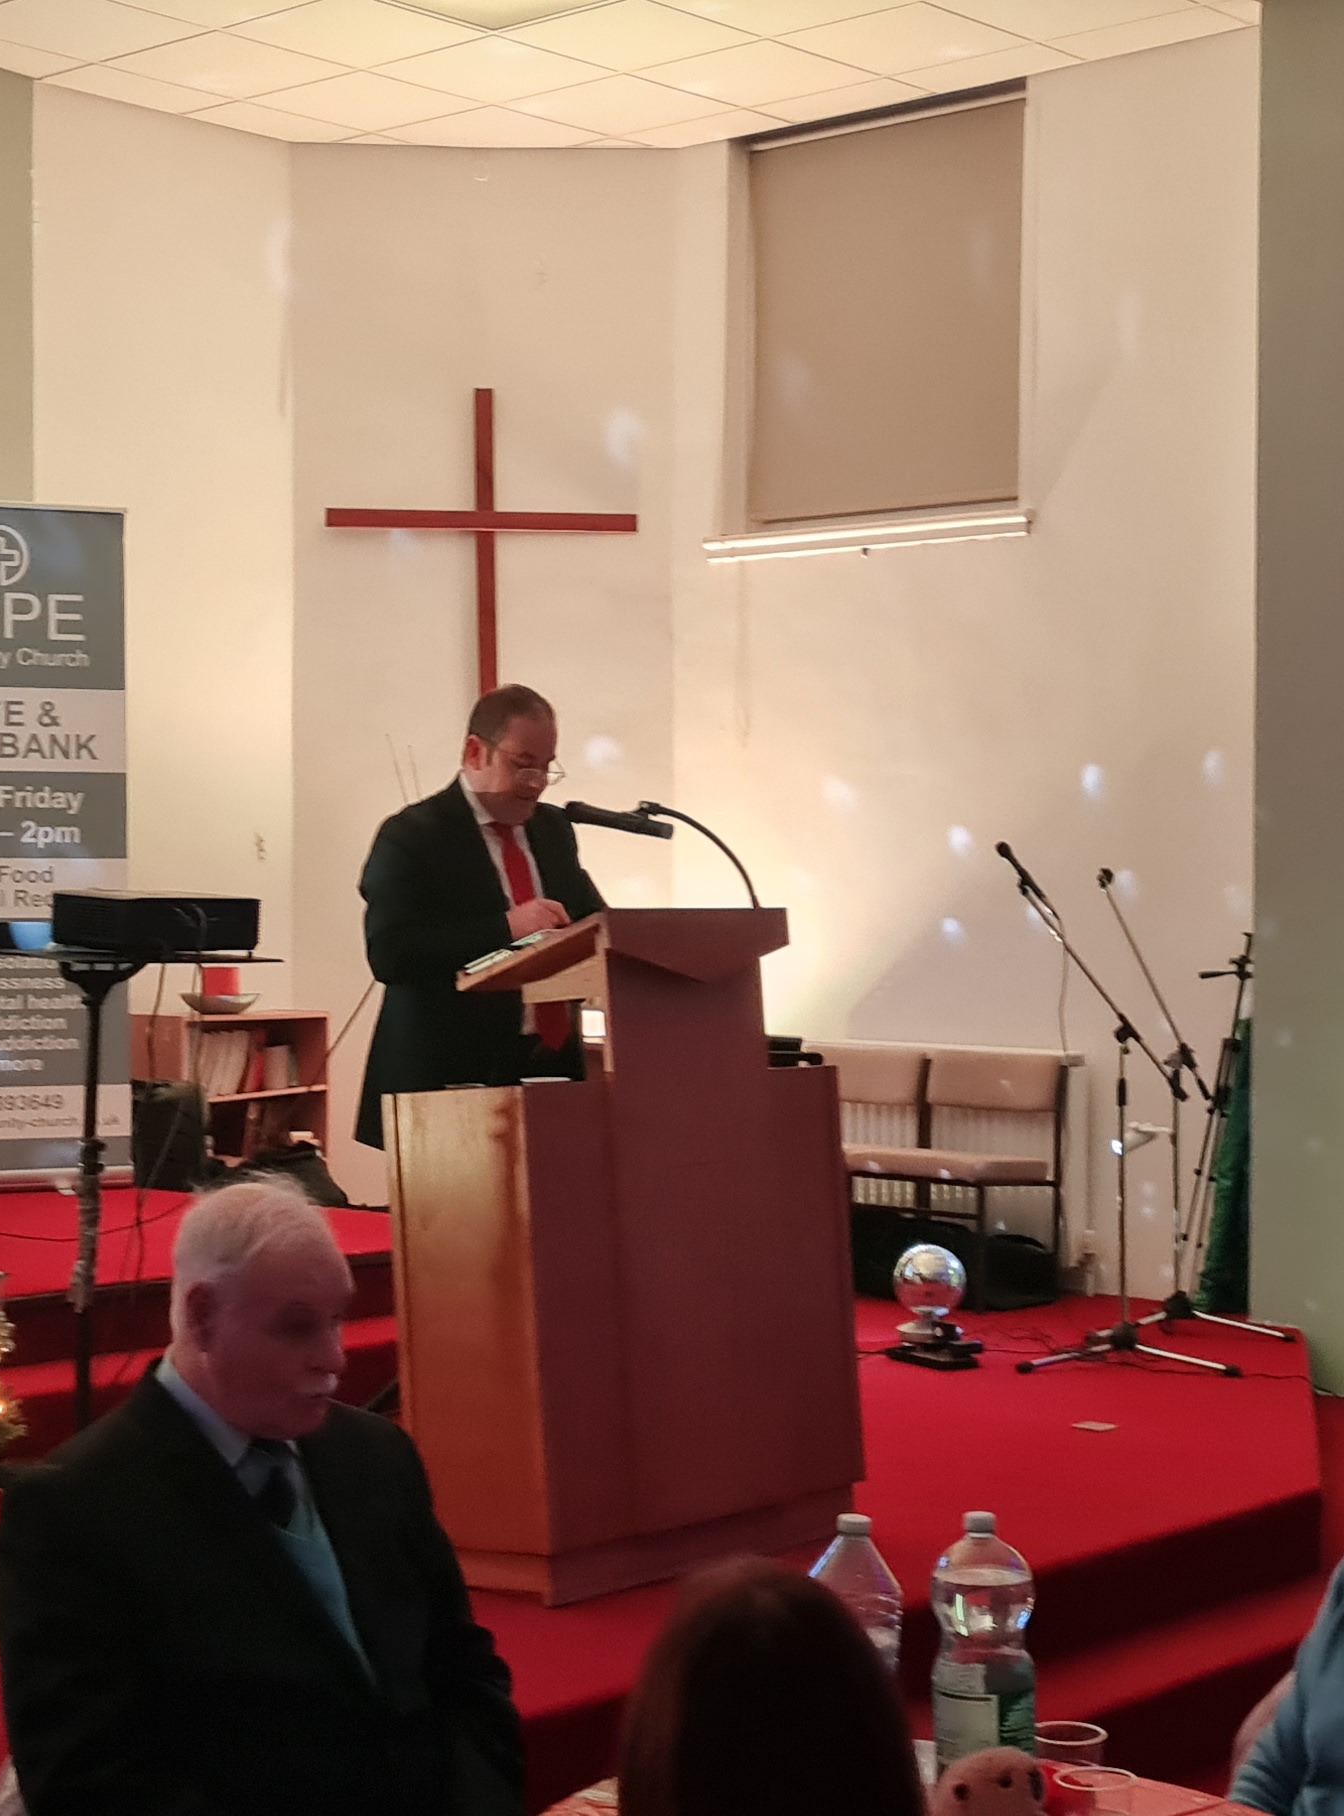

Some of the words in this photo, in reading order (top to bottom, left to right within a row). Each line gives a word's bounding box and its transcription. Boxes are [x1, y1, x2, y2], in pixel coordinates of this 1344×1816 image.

[16, 647, 90, 668] Church
[37, 700, 61, 728] &
[19, 820, 82, 849] 2pm
